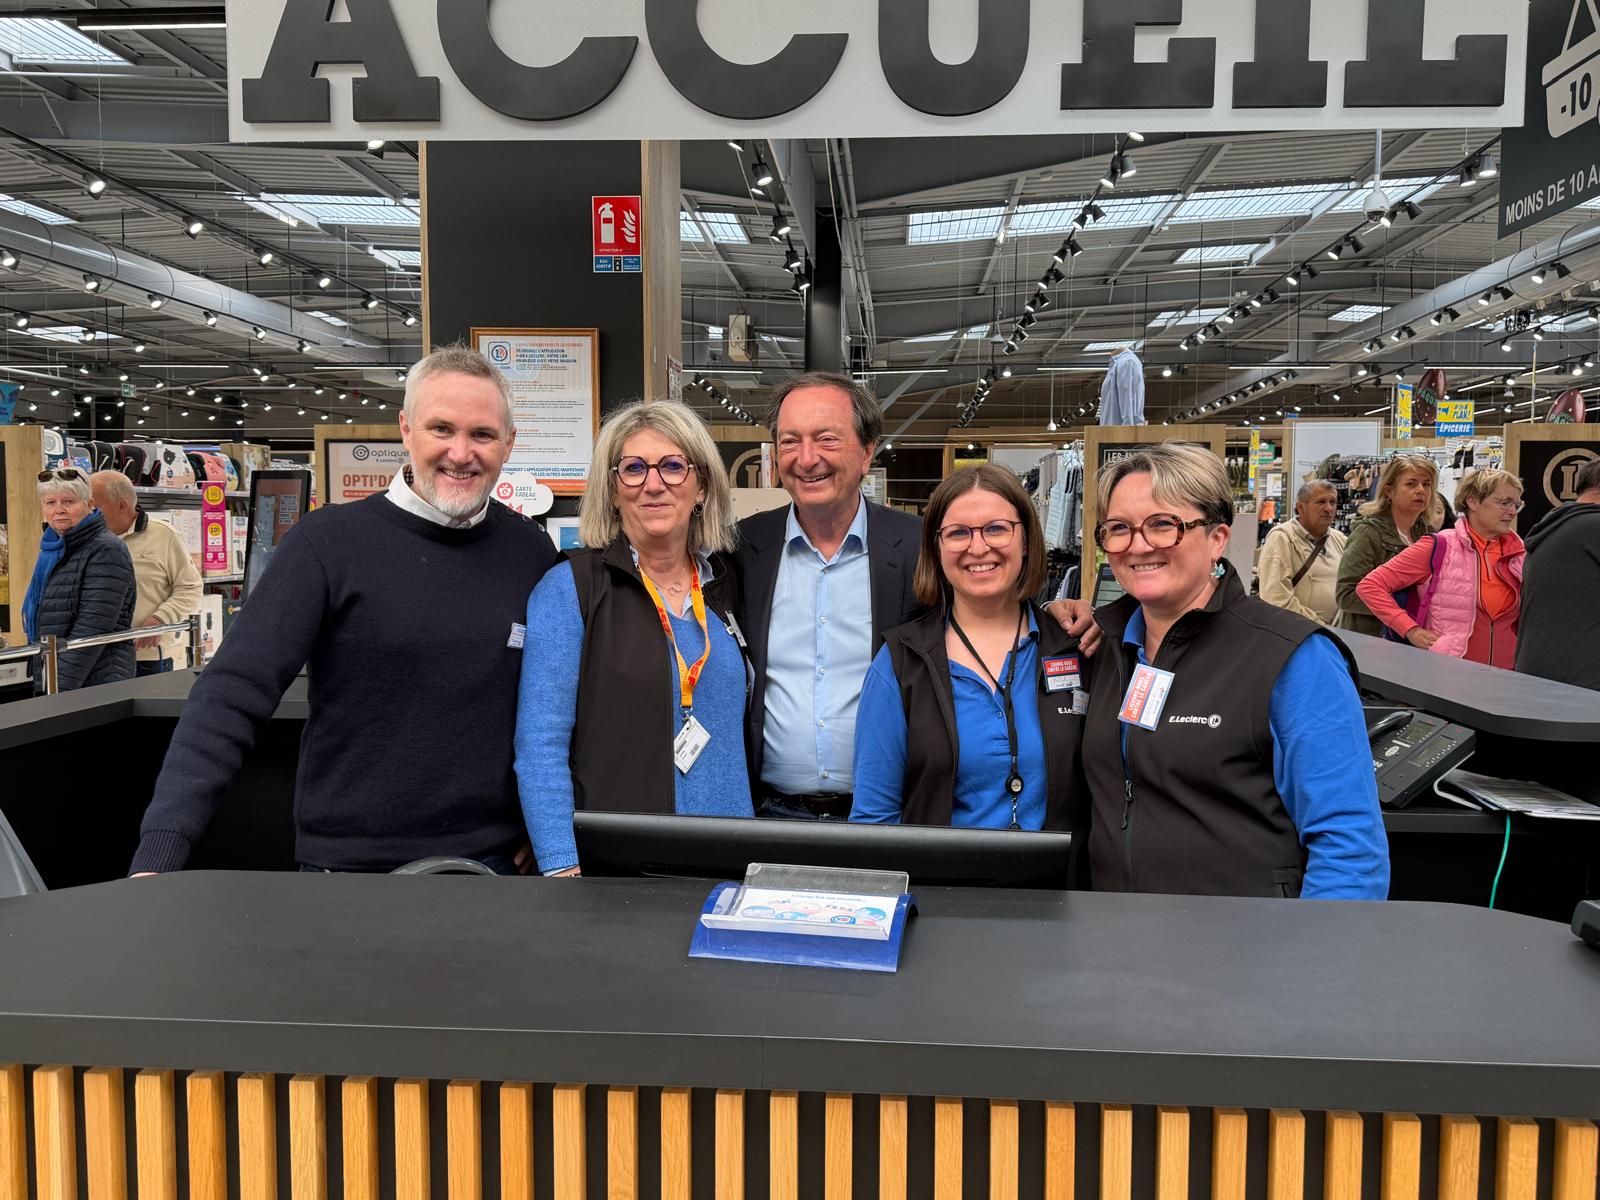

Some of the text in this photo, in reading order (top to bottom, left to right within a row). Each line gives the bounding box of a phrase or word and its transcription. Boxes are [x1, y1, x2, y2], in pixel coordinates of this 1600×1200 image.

[1560, 72, 1592, 117] -10
[1505, 164, 1600, 226] MOINS DE 10 A
[1439, 422, 1470, 433] ÉPICERIE
[371, 449, 410, 457] optique
[1169, 715, 1207, 724] E.Leclerc
